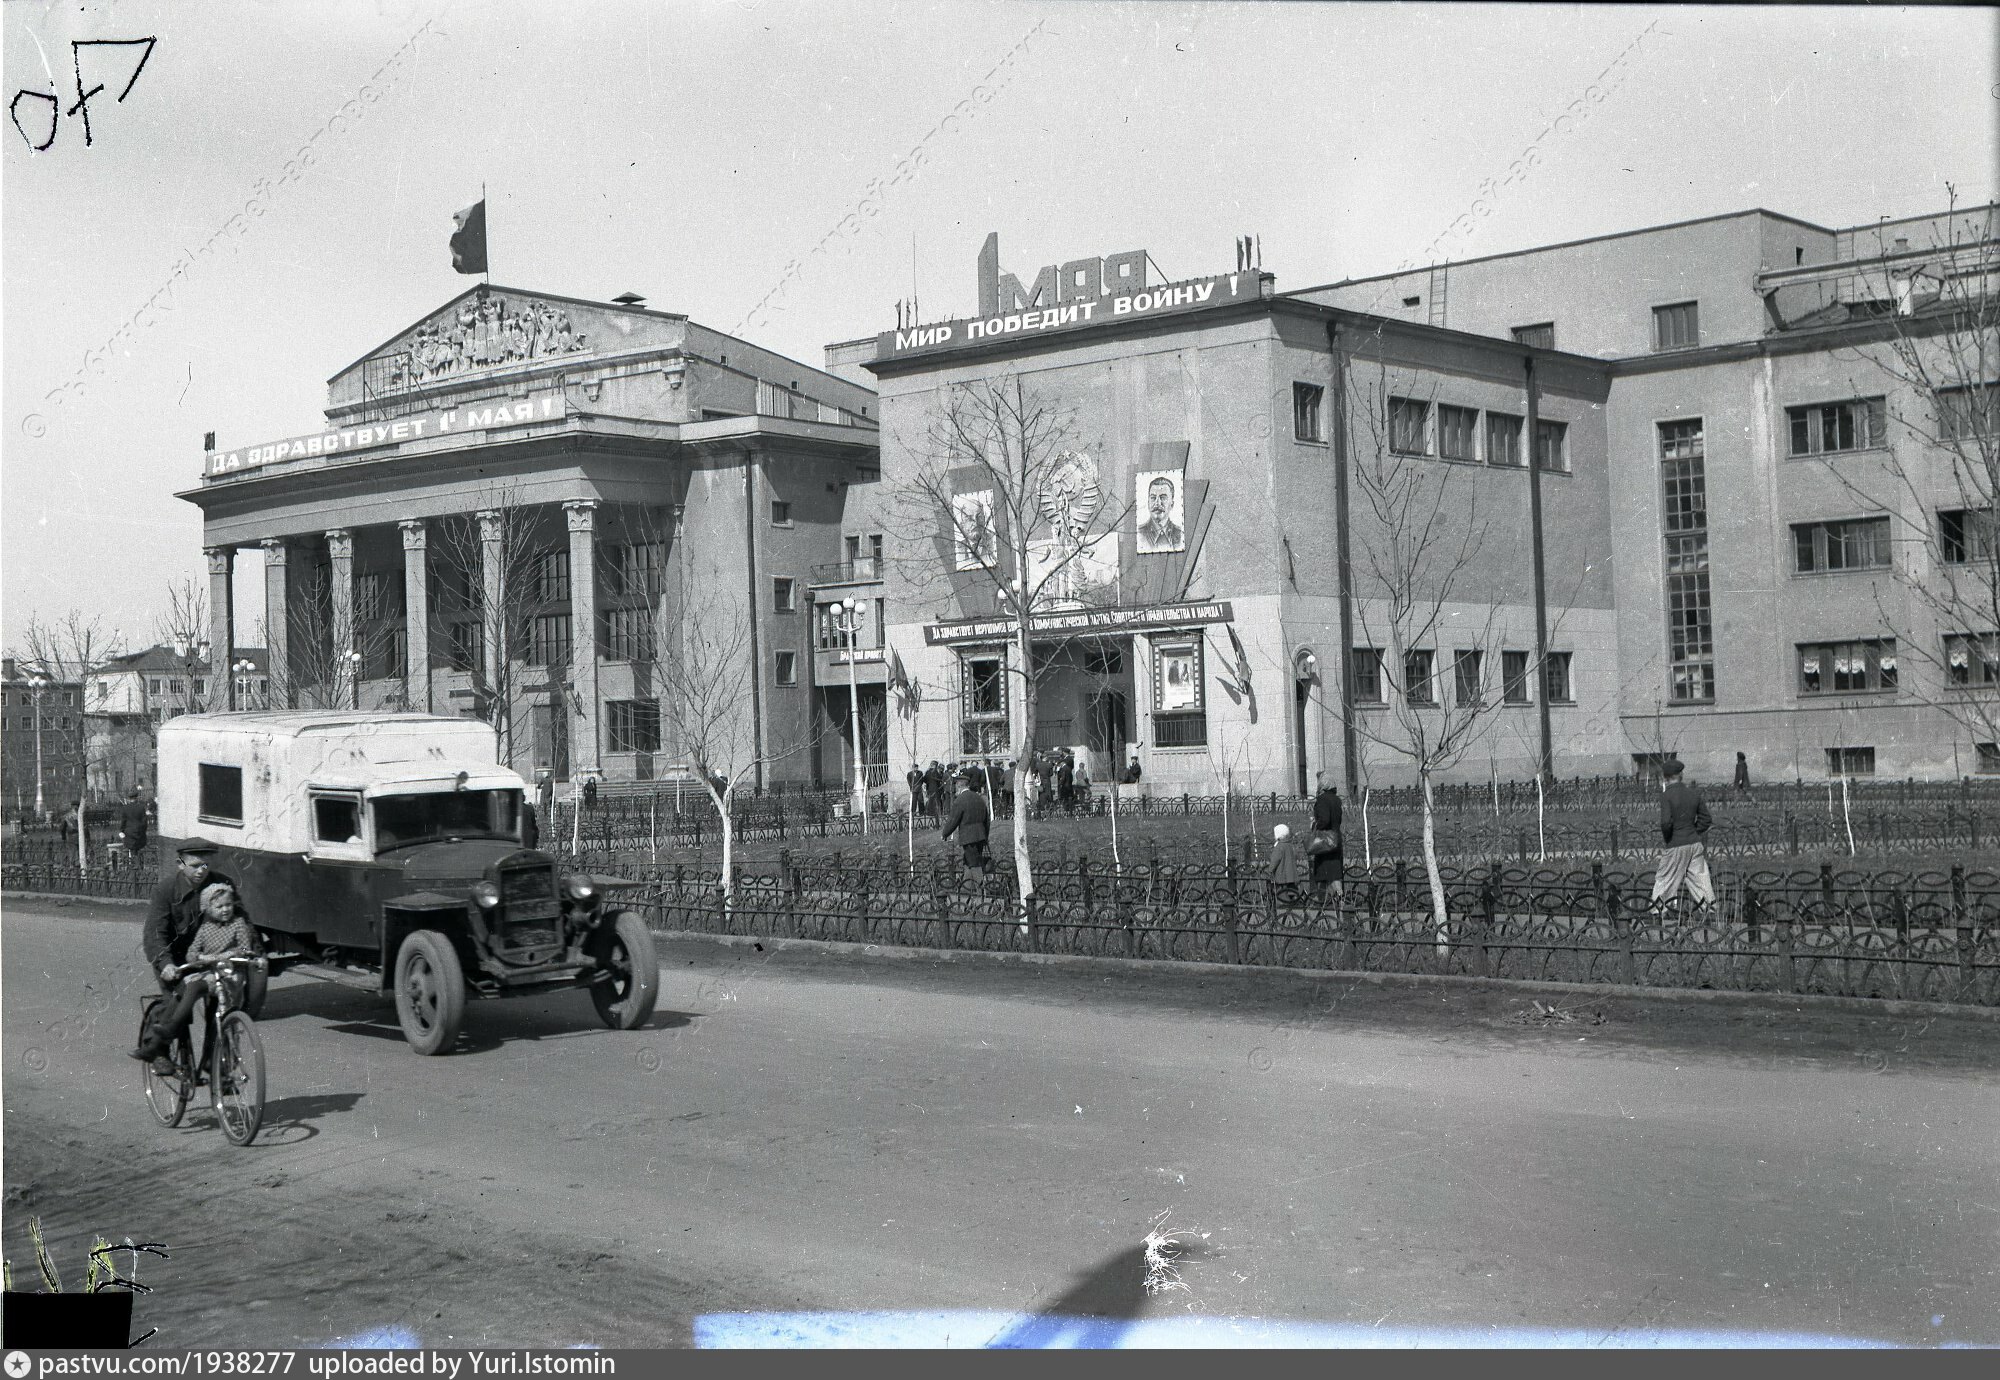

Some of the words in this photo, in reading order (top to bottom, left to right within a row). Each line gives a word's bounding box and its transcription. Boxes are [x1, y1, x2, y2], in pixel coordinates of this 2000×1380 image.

[978, 232, 998, 315] 1
[212, 453, 239, 473] ДА
[248, 419, 426, 464] ЗДРАВСТВУЕТ
[468, 403, 533, 427] МАЯ
